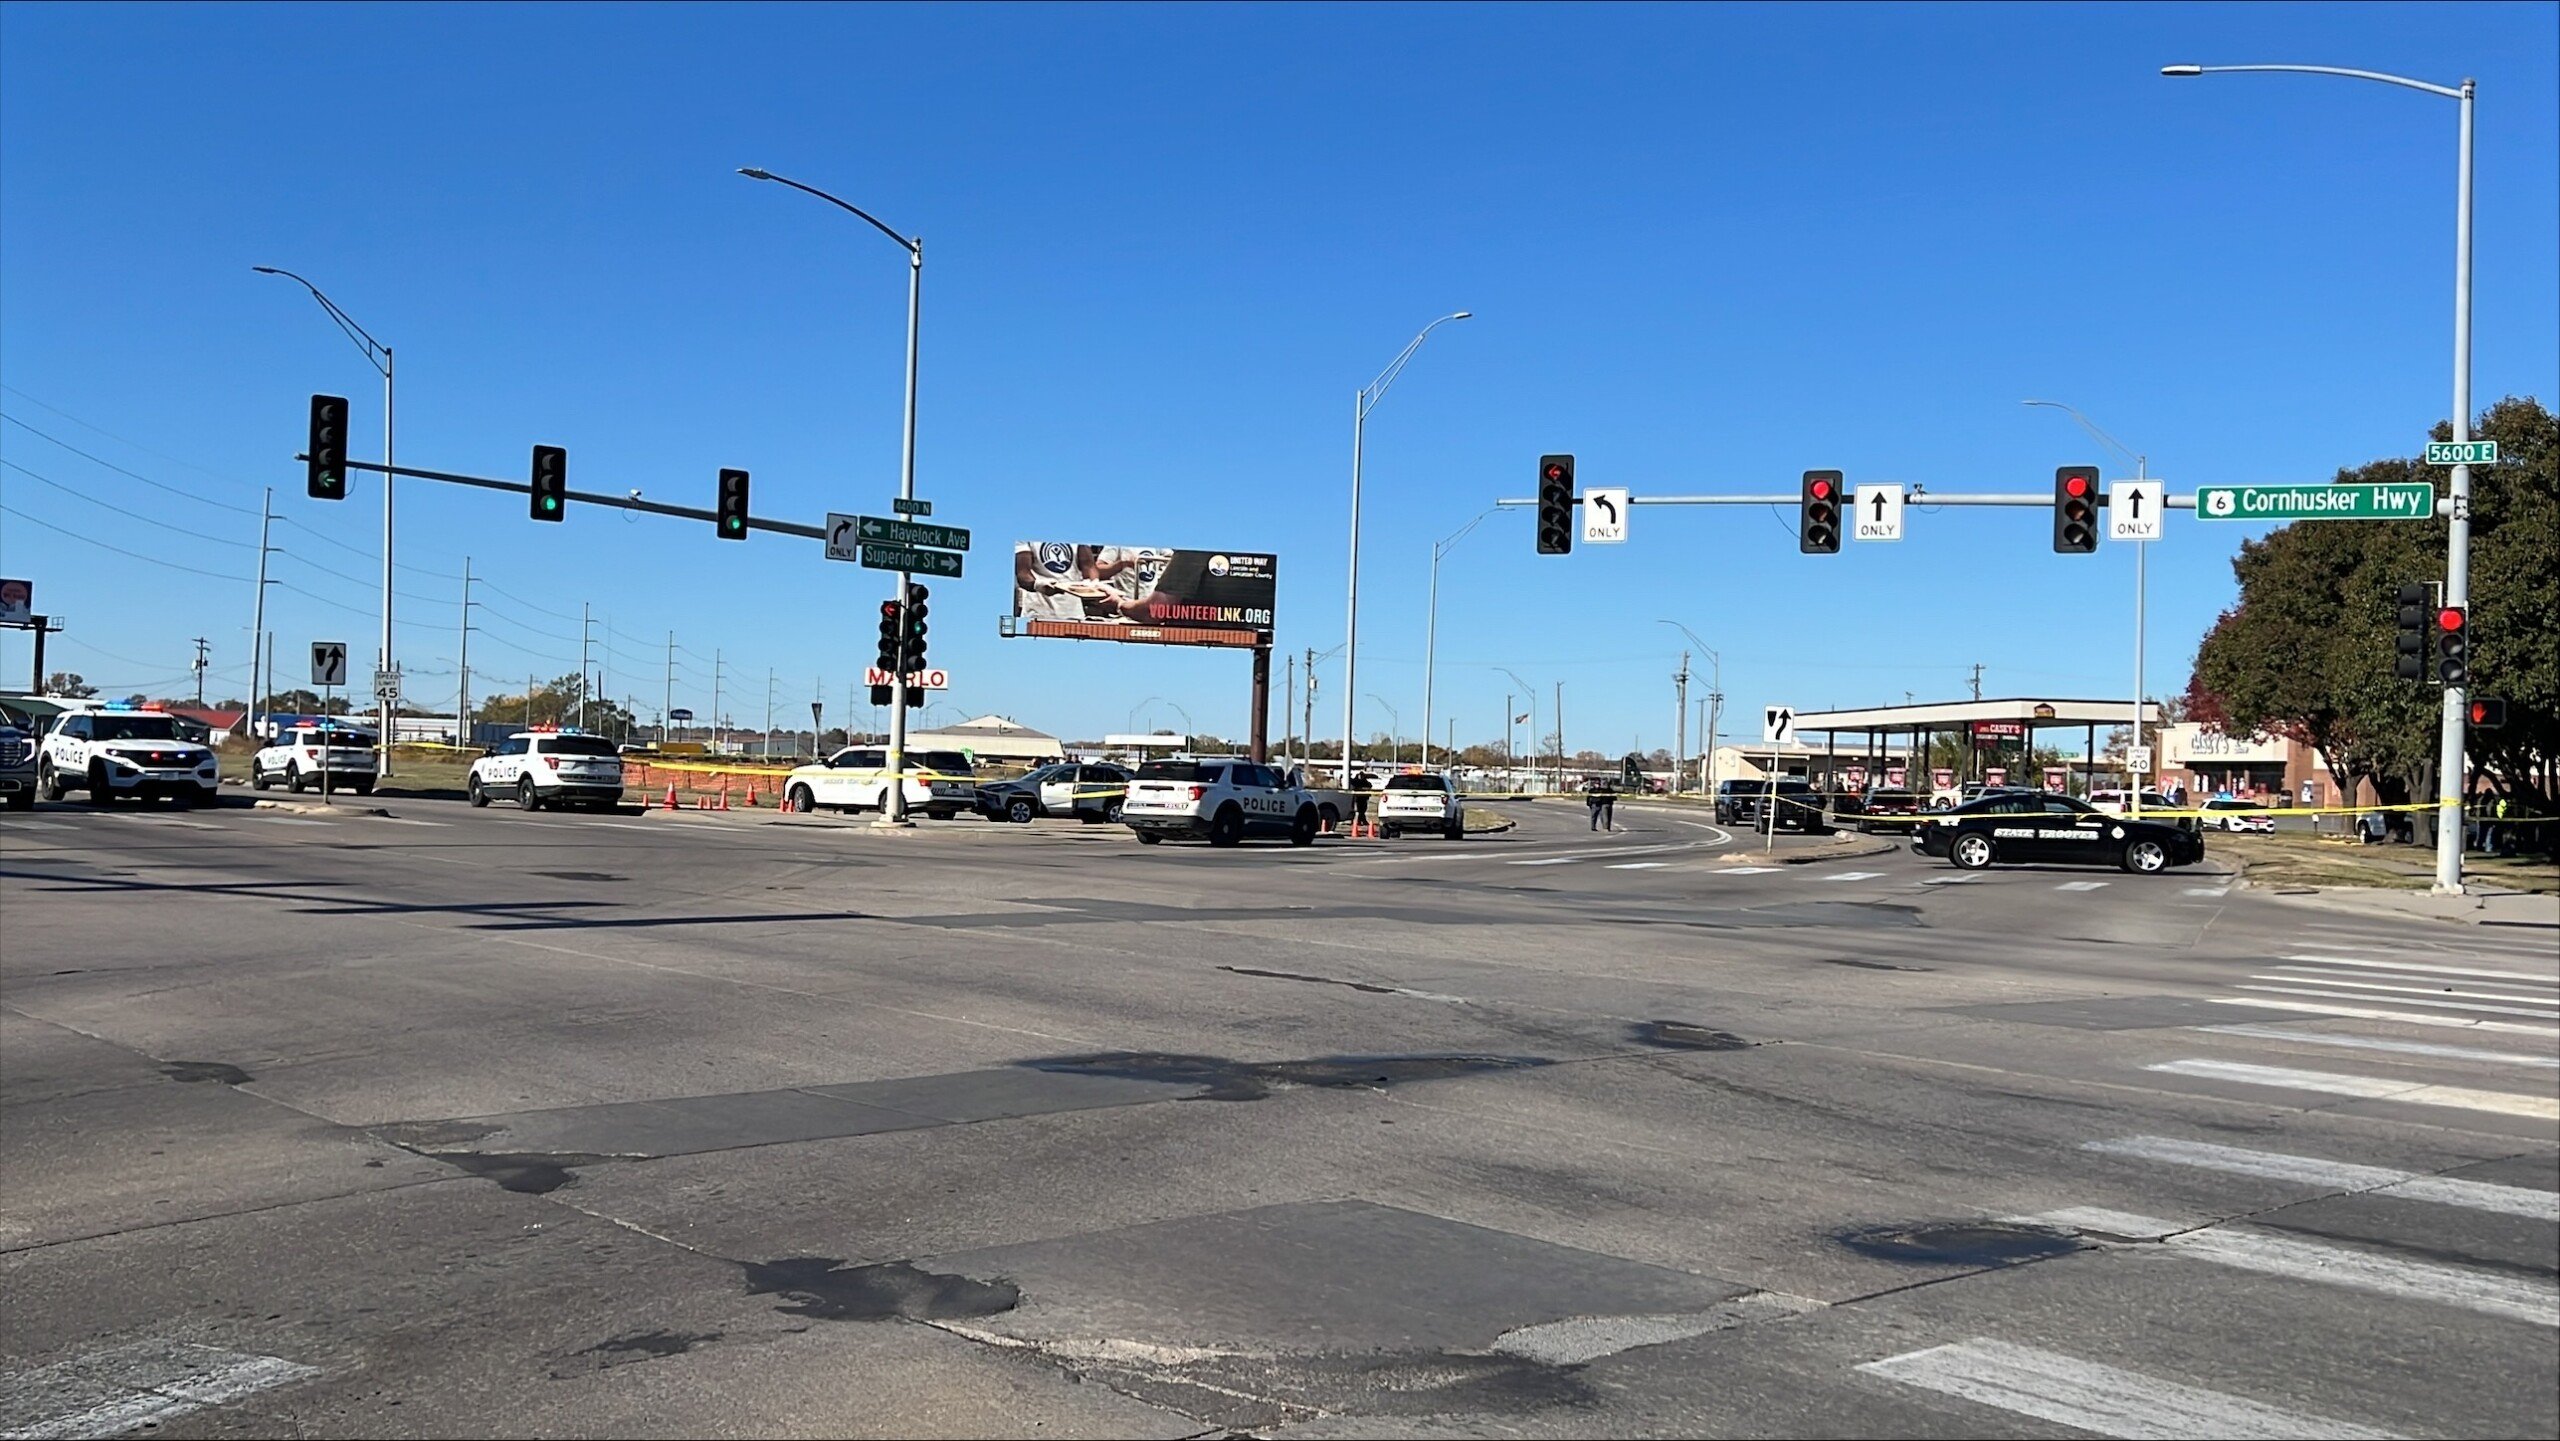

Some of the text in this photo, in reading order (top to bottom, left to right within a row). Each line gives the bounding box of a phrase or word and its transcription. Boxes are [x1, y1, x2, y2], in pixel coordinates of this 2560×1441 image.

[2430, 444, 2492, 461] 5600 E
[895, 500, 930, 514] 4400 N
[2215, 496, 2226, 510] 6
[2242, 487, 2422, 515] Cornhusker Hwy
[1589, 527, 1621, 538] ONLY
[1860, 525, 1895, 536] ONLY
[2117, 523, 2153, 535] ONLY
[890, 523, 967, 548] Havelock Ave
[830, 546, 852, 557] ONLY
[865, 545, 936, 569] Superior St
[1230, 556, 1268, 567] UNITED WAY
[1149, 603, 1271, 624] VOLUNTEERLNK.ORG
[376, 687, 398, 698] 45
[1990, 723, 2021, 734] CASEY'S
[55, 747, 84, 764] POLICE
[268, 754, 287, 765] POLICE
[2129, 760, 2148, 770] 40
[488, 766, 517, 778] POLICE
[1243, 797, 1286, 813] POLICE
[1994, 828, 2100, 840] STATE TROOPER
